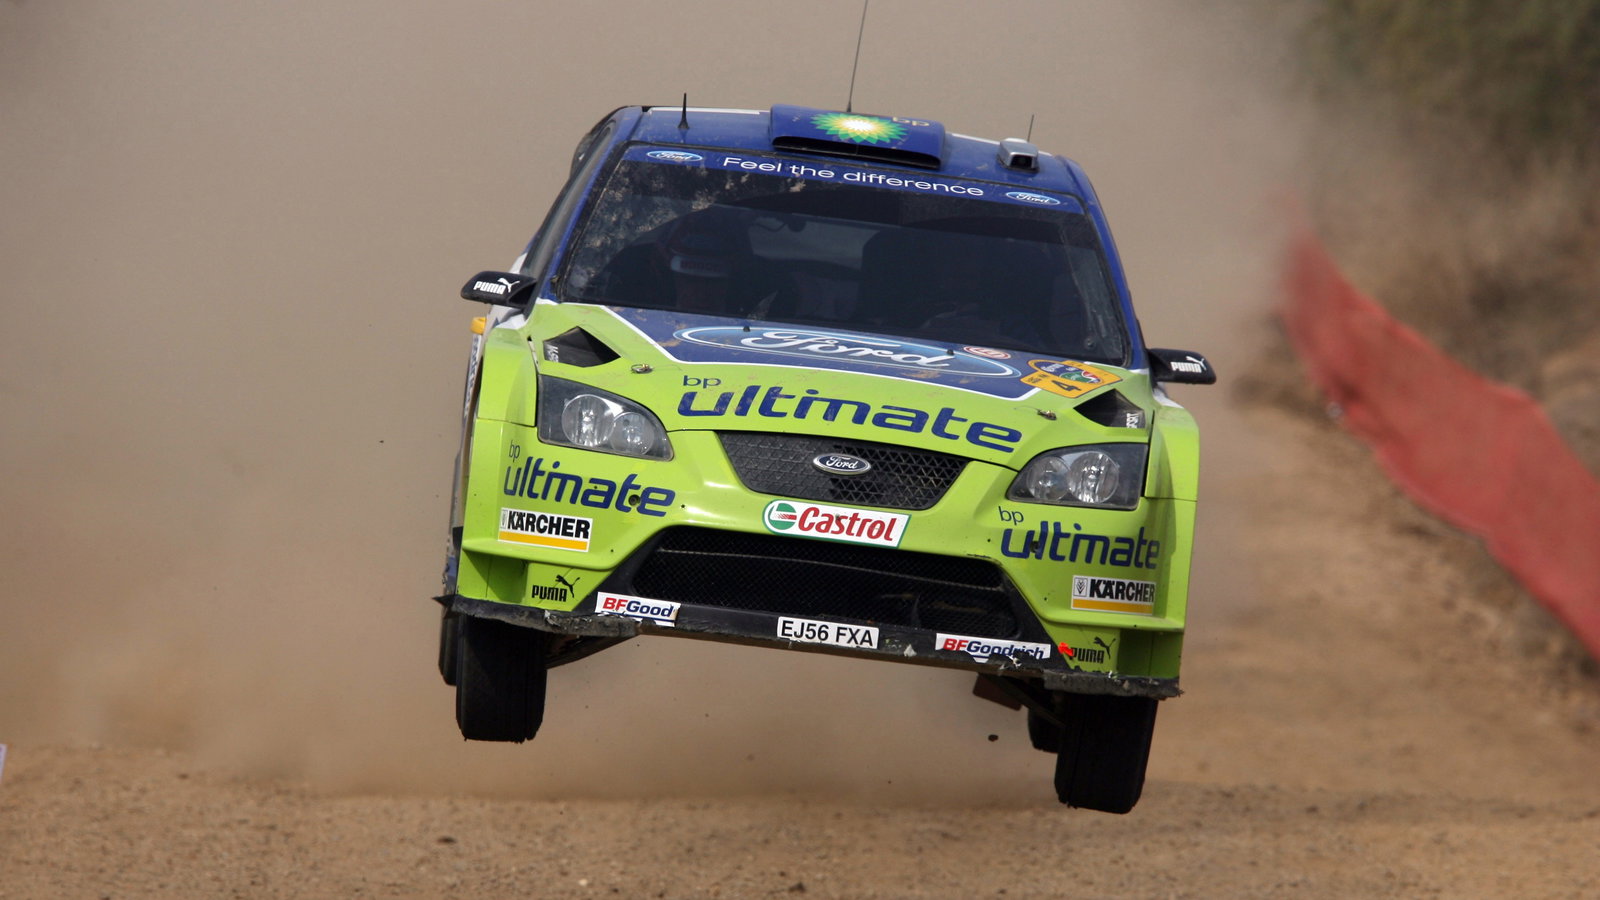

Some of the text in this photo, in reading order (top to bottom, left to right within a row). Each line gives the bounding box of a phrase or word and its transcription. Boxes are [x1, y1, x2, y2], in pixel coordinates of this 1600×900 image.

[655, 152, 693, 161] Ford
[723, 157, 984, 196] Feel the difference
[1015, 193, 1049, 203] Ford
[473, 281, 506, 294] PUMA
[741, 331, 955, 367] Ford
[1170, 361, 1201, 373] PUMA
[683, 375, 721, 389] bp
[1051, 379, 1082, 392] 4
[677, 385, 1023, 453] ultimate
[509, 440, 521, 462] bp
[825, 456, 858, 470] Ford
[503, 456, 676, 517] ultimate
[507, 510, 591, 539] KÄRCHER
[798, 506, 898, 541] Castrol
[998, 506, 1024, 525] bp
[1001, 521, 1161, 570] ultimate
[531, 584, 567, 602] PUMA
[1089, 578, 1156, 603] KÄRCHER
[602, 597, 675, 618] BFGood
[781, 620, 874, 647] EJ56 FXA
